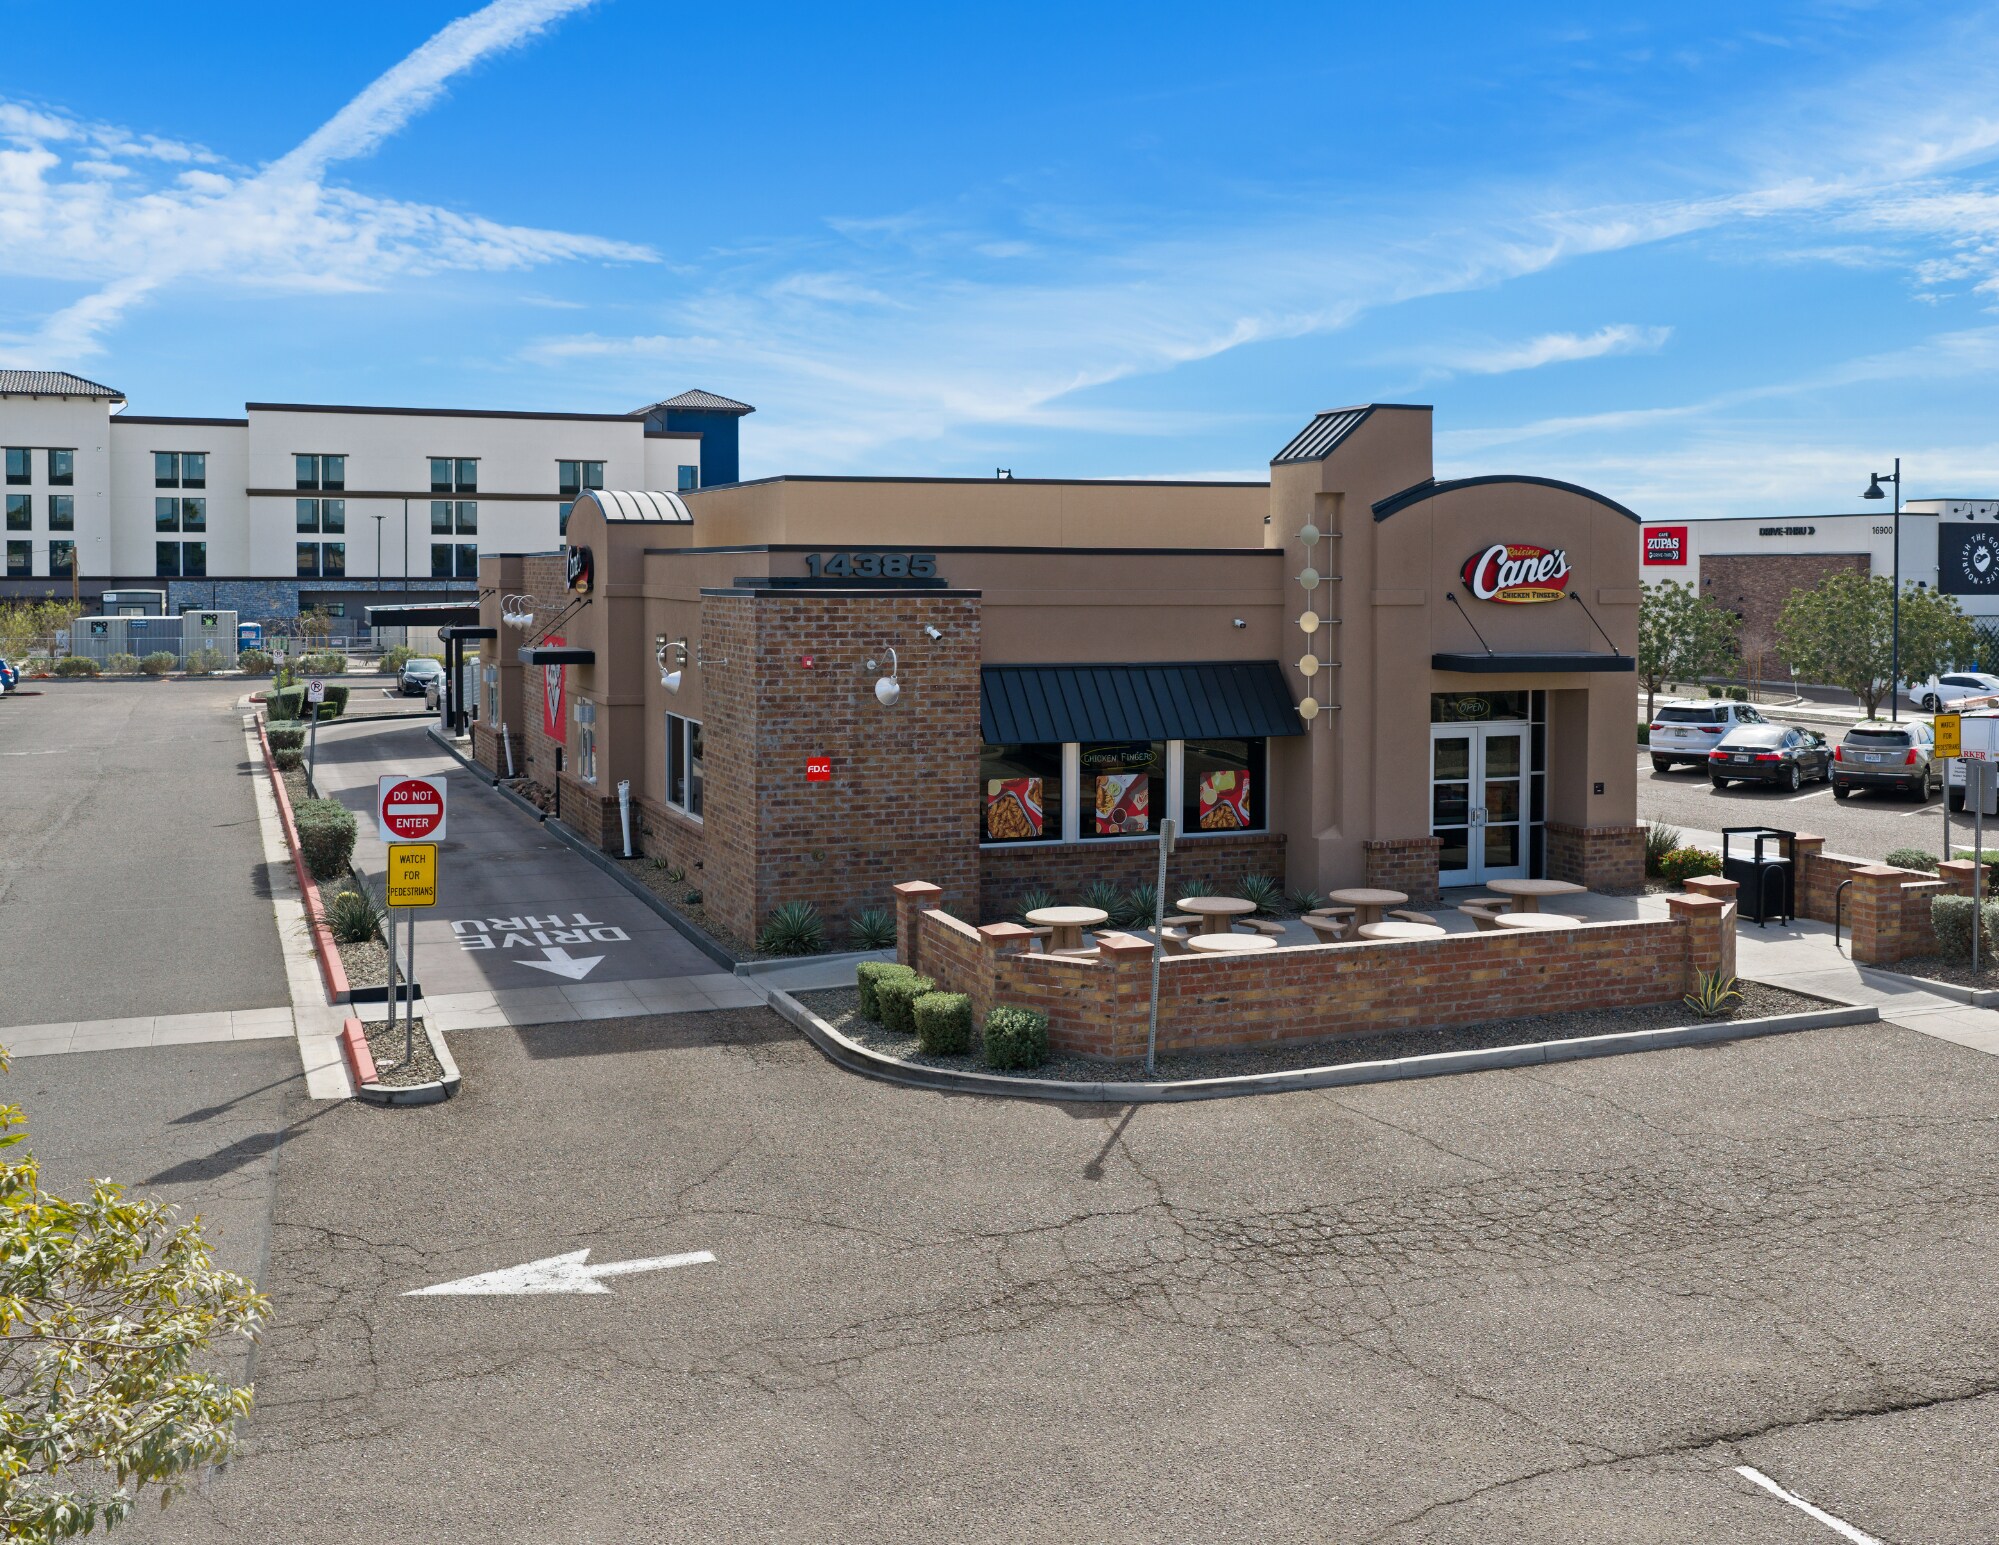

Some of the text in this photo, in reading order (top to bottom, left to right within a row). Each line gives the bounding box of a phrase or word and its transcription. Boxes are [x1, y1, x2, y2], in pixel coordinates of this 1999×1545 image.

[1759, 526, 1807, 536] DRIVE-THRU
[1872, 526, 1893, 535] 16900
[1647, 537, 1680, 549] ZUPAS
[1507, 547, 1540, 558] Raising
[1962, 544, 1979, 585] NOURISH
[1971, 533, 1986, 543] THE
[805, 553, 937, 578] 14385
[1473, 544, 1572, 600] Cane's
[1502, 591, 1560, 599] CHICKEN FINGERS
[1460, 702, 1484, 712] OPEN
[1084, 752, 1153, 763] CHICKEN FINGERS
[1957, 750, 1987, 760] RKER
[393, 790, 433, 801] DO NOT
[396, 818, 429, 828] ENTER
[399, 854, 426, 864] WATCH
[404, 871, 420, 880] FOR
[390, 887, 433, 897] PEDESTRIANS
[450, 913, 604, 934] THRU
[454, 926, 632, 950] DRIVE
